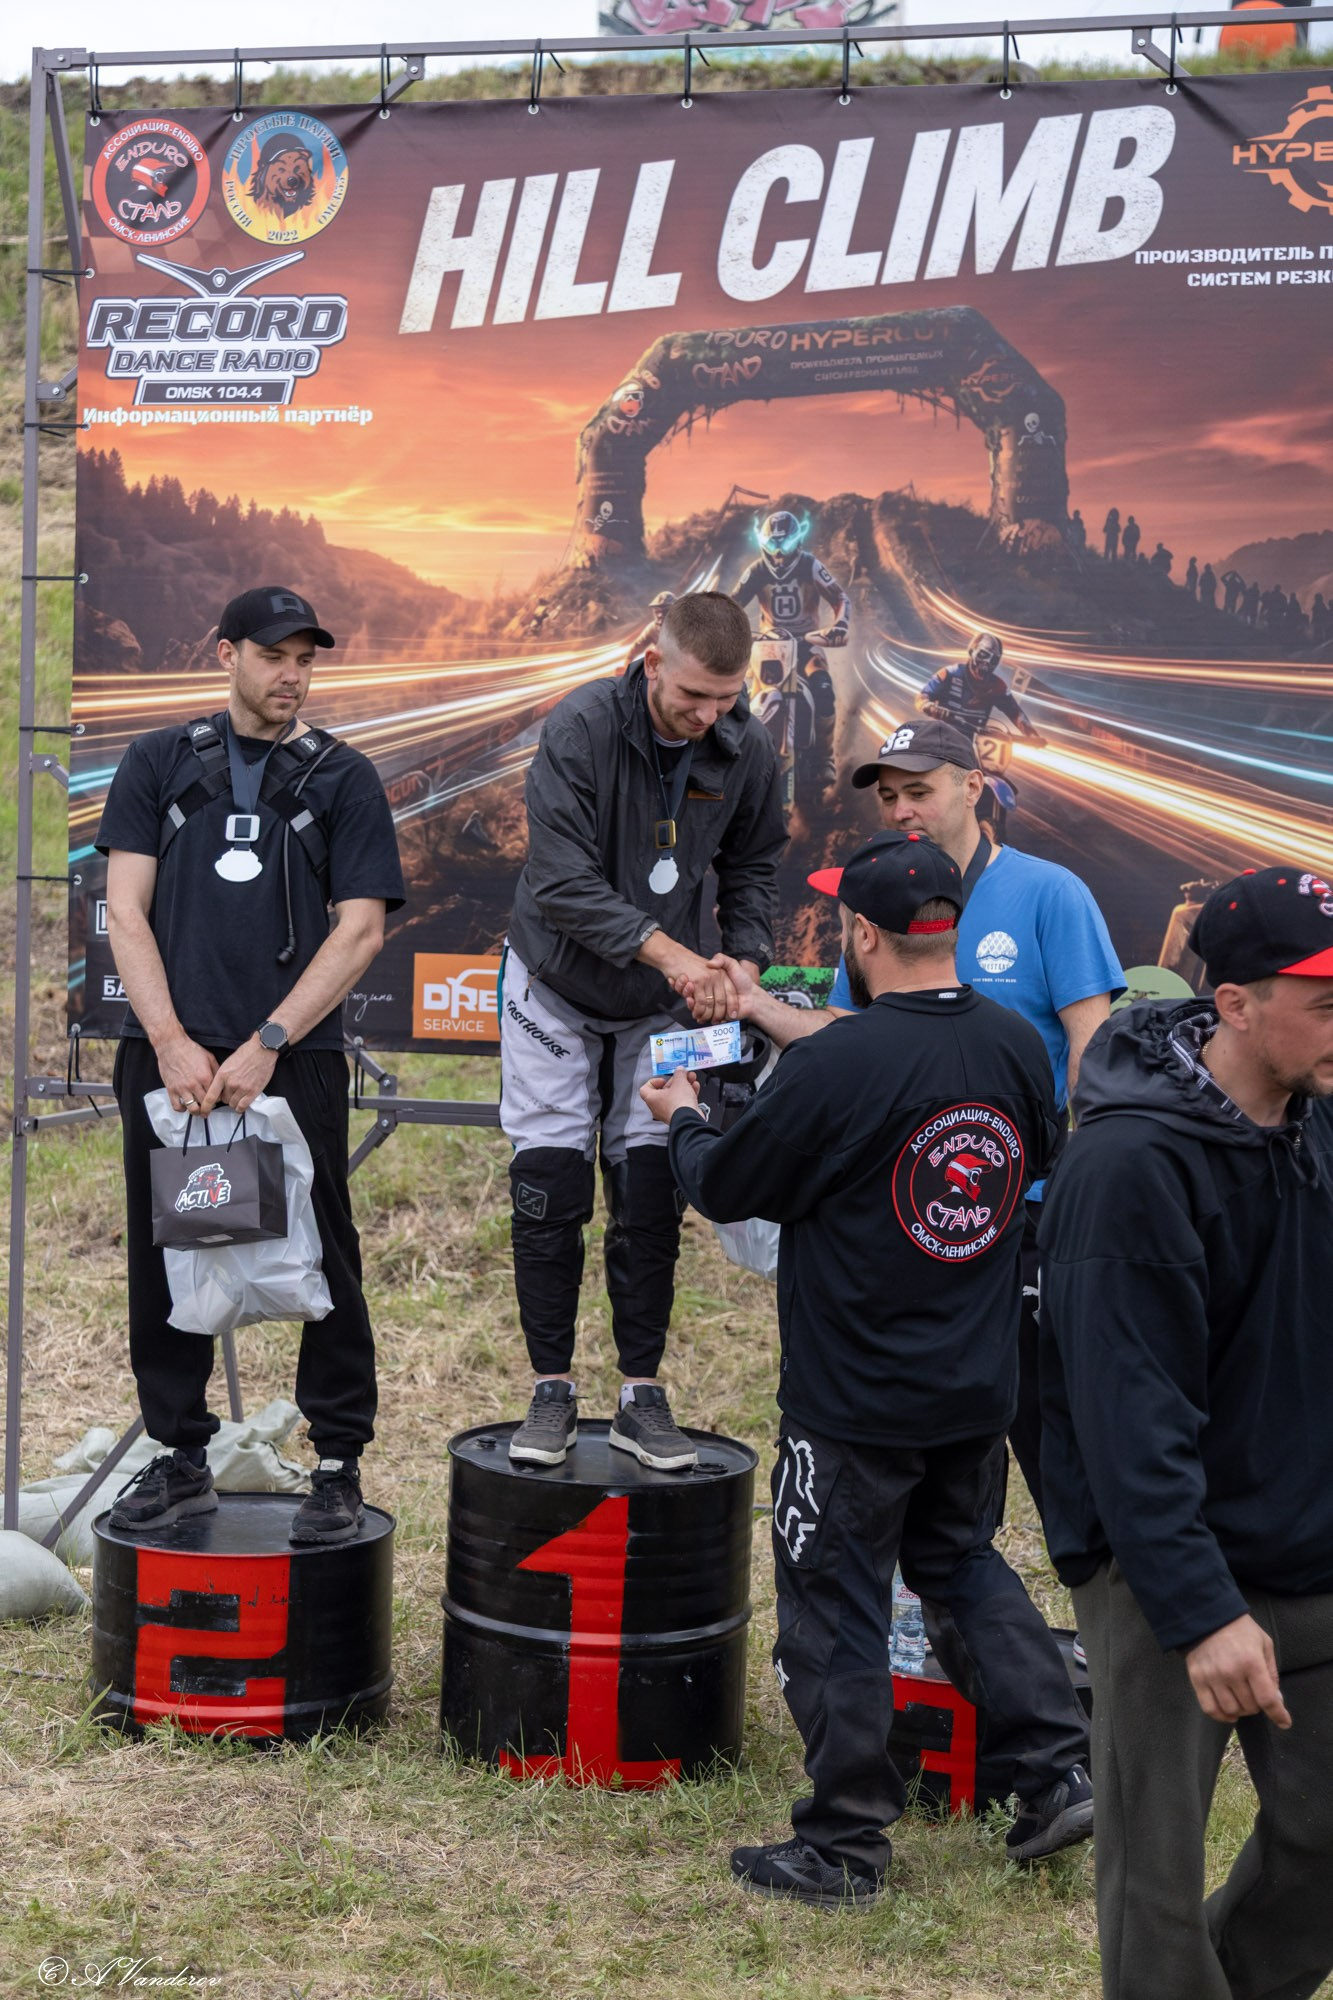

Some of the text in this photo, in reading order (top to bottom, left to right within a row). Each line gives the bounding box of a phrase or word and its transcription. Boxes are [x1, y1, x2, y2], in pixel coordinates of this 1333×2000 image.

[103, 121, 204, 161] АССОЦИАЦИЯ-ENDURO
[231, 113, 342, 162] ПРОСТЫЕ ПАРНИ
[115, 141, 189, 172] ENDURO
[108, 215, 191, 243] ОМСК-ЛЕНИНСКИЕ
[399, 105, 1176, 334] HILL CLIMB
[267, 229, 299, 242] 2022
[1134, 246, 1315, 265] ПРОИЗВОДИТЕЛЬ
[1187, 269, 1333, 287] СИСТЕМ РЕЗК
[88, 300, 347, 343] RECORD
[113, 348, 316, 373] DANCE RADIO
[165, 385, 263, 400] OMSK 104.4
[83, 405, 373, 427] Информационный партнёр
[423, 1018, 485, 1033] SERVICE
[506, 999, 571, 1060] FASTHOUSE
[712, 1026, 735, 1038] 3000
[910, 1108, 1020, 1159] АССОЦИАЦИЯ-ENDURO
[927, 1132, 1005, 1168] ENDURO
[177, 1180, 230, 1207] ACTIVE
[911, 1222, 998, 1259] ОМСК-ЛЕНИНСКИЕ
[135, 1547, 291, 1738] 2
[499, 1496, 682, 1791] 1
